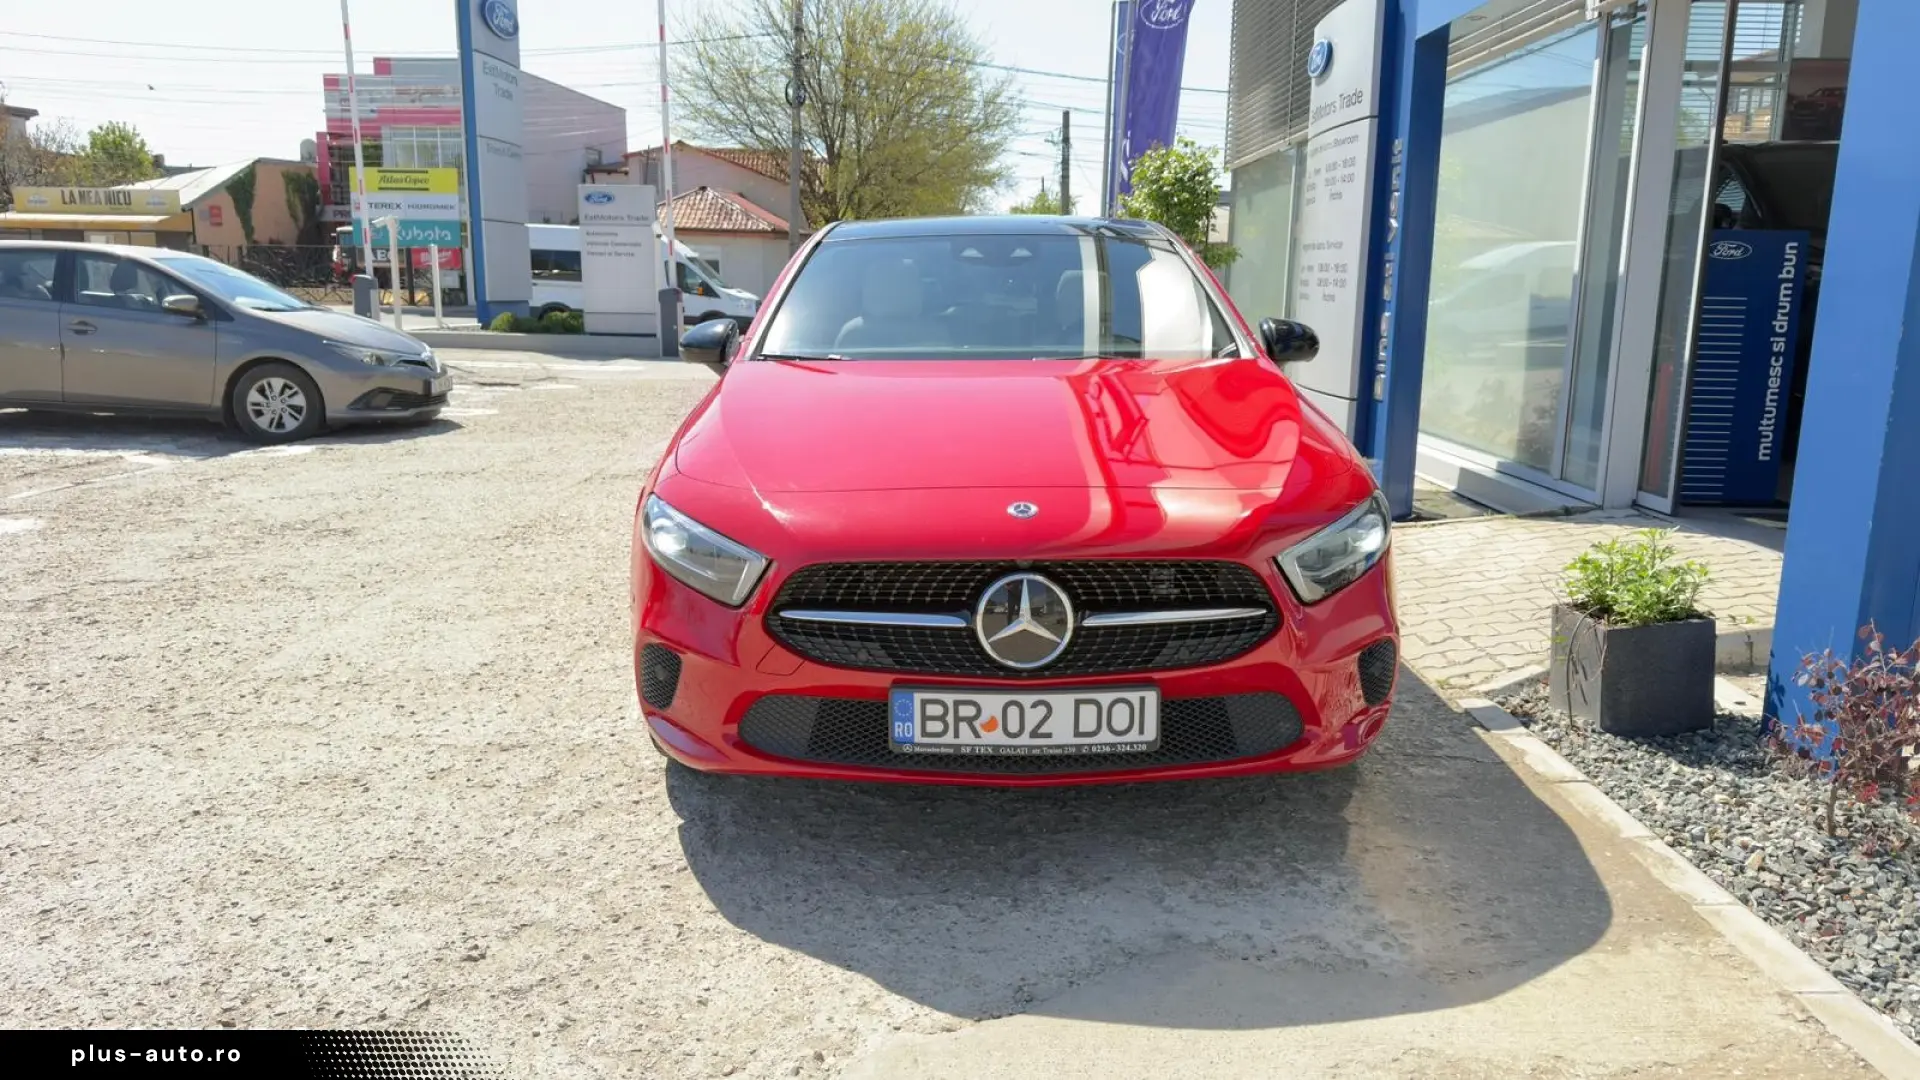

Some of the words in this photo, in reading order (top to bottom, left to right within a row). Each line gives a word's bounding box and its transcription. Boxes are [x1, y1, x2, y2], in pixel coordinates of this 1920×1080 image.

[1151, 0, 1181, 22] Ford
[1338, 88, 1363, 111] Trade
[61, 189, 77, 205] LA
[78, 190, 102, 206] NEA
[104, 190, 132, 206] NICU
[368, 202, 402, 210] TEREX
[1713, 243, 1744, 256] Ford
[1778, 241, 1799, 279] bun
[1772, 283, 1793, 333] drum
[1771, 336, 1786, 352] si
[1757, 356, 1784, 461] multumesc
[920, 698, 982, 739] BR
[1001, 699, 1053, 739] 02
[1073, 696, 1146, 738] DOI
[894, 721, 913, 738] RO
[974, 746, 993, 754] TEX
